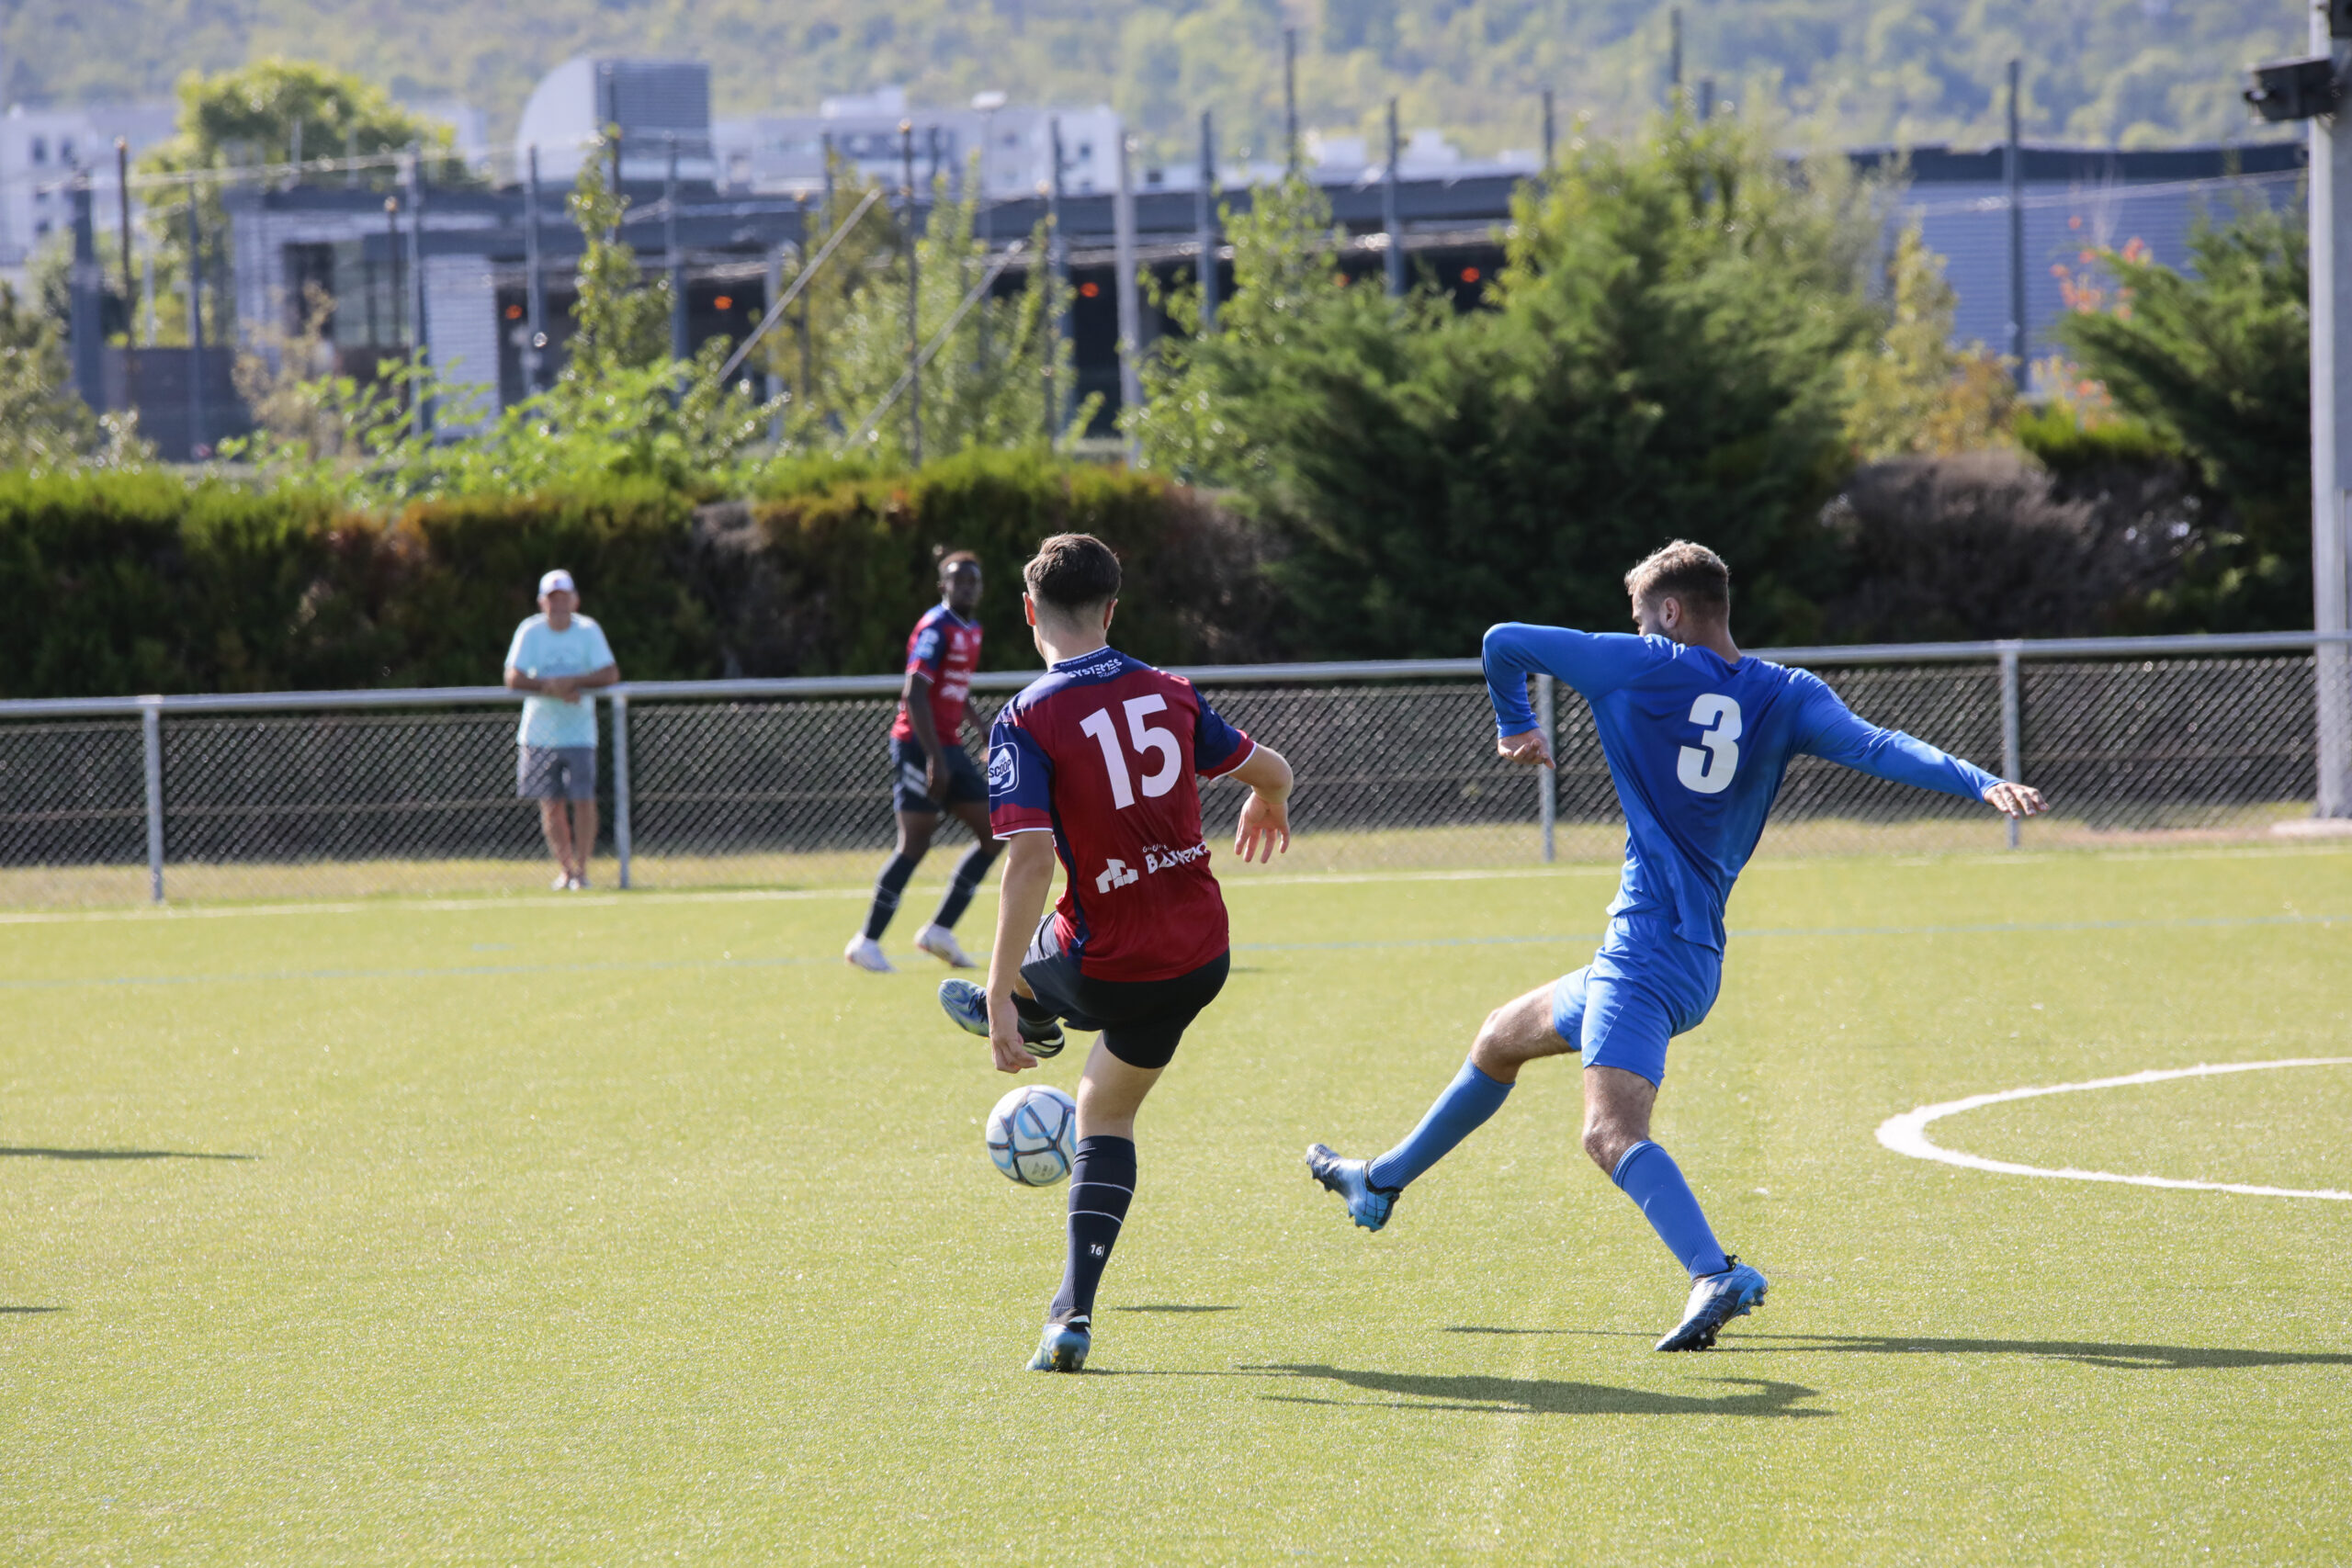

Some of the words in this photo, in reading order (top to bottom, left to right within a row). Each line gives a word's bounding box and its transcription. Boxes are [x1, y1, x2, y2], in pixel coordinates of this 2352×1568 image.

[989, 759, 1012, 778] SCOOP
[1080, 694, 1182, 810] 15
[1677, 693, 1742, 795] 3
[1091, 1244, 1102, 1256] 16
